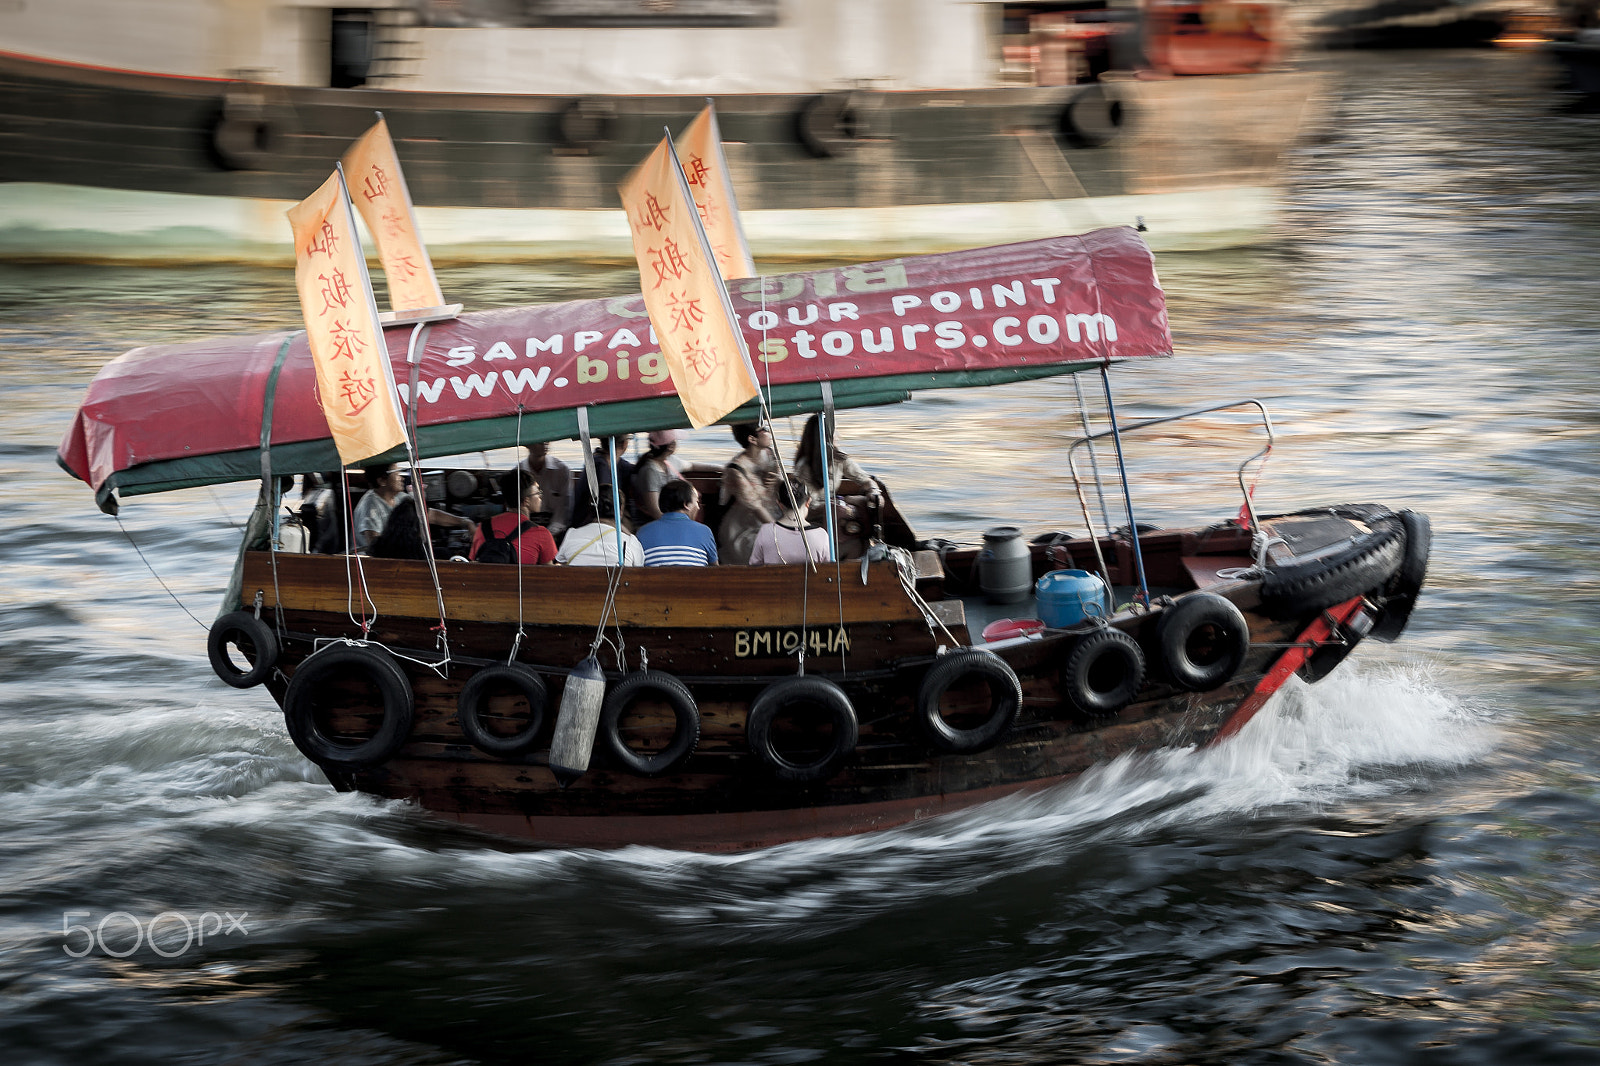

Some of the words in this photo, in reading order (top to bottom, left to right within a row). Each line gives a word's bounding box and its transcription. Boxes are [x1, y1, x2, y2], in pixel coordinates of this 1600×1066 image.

[735, 302, 860, 331] OUR
[891, 277, 1062, 317] POINT
[397, 312, 1118, 404] www.bigstours.com
[735, 627, 850, 657] BM10141A
